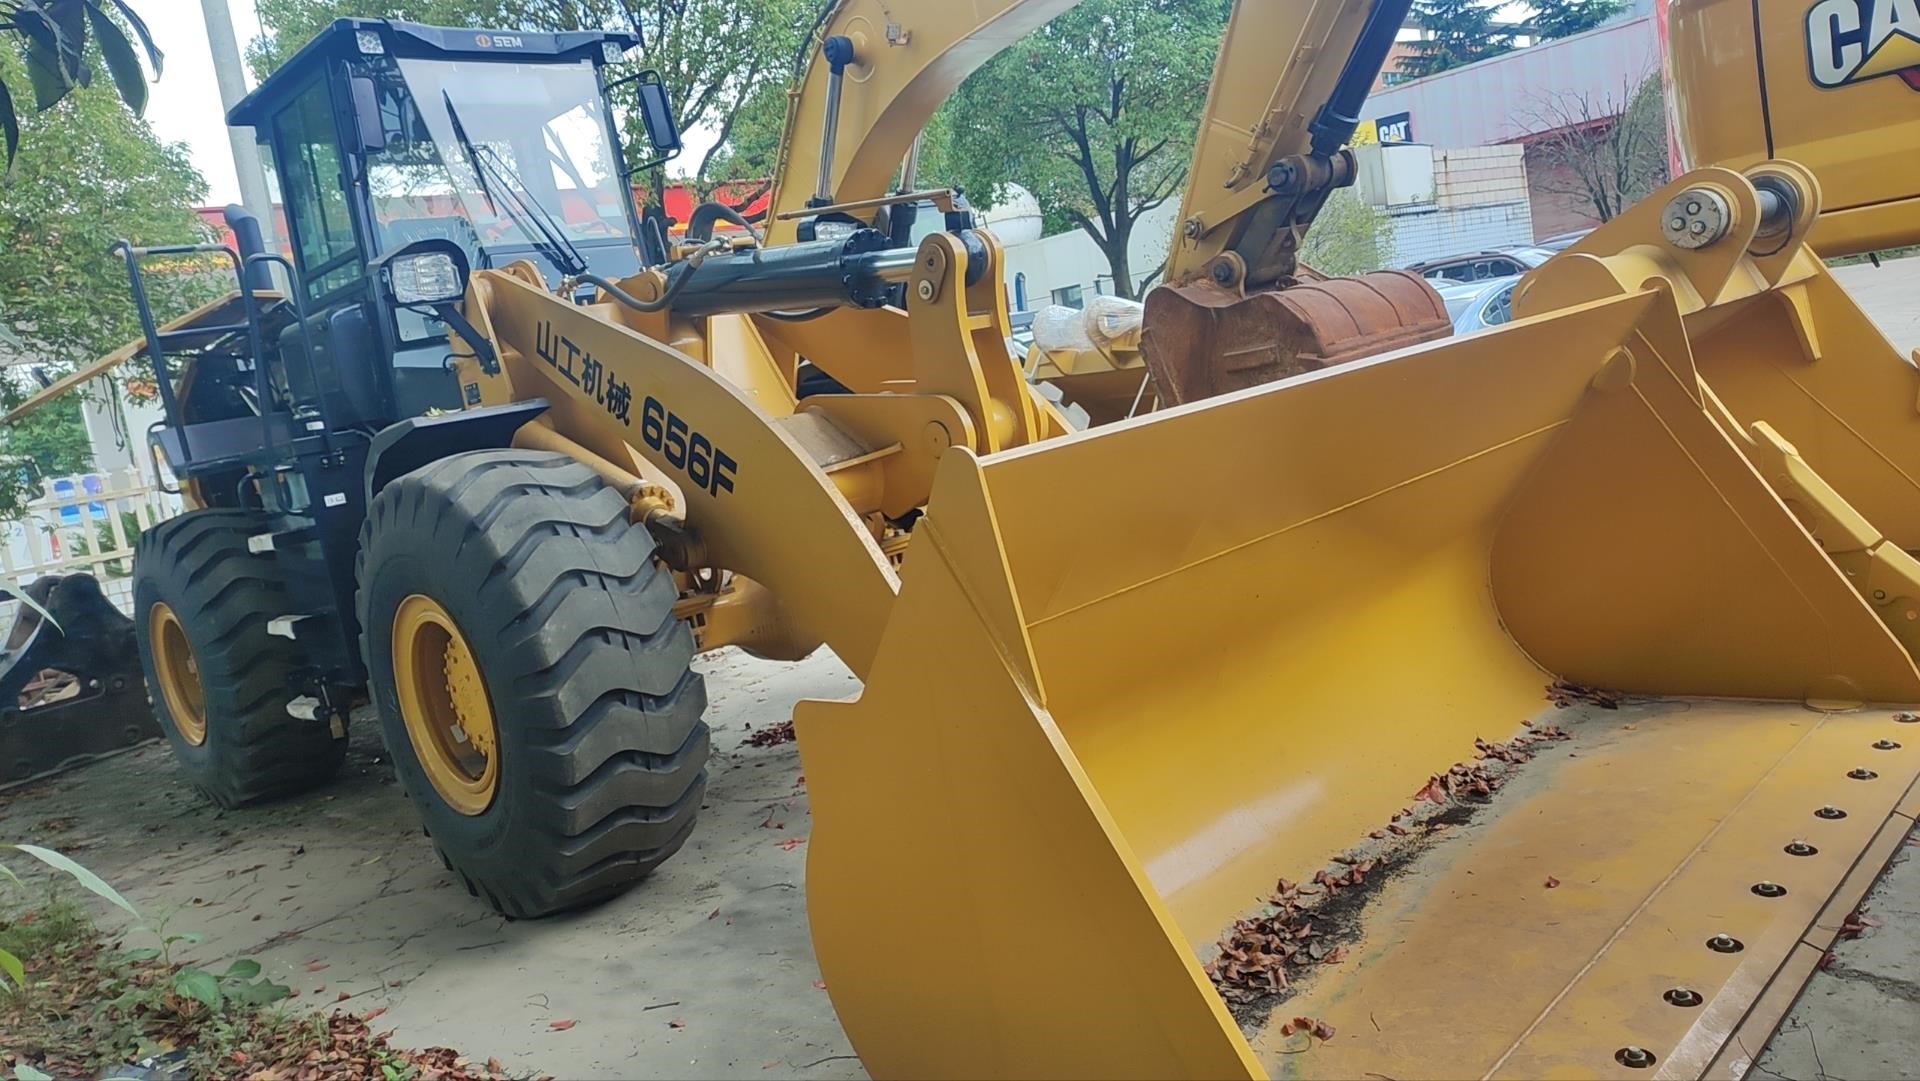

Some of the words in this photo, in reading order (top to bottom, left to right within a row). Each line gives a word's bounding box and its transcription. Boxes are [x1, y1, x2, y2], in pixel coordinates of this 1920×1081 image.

[493, 36, 523, 48] SEM
[1379, 121, 1408, 142] CAT
[536, 320, 632, 427] 山工机械
[641, 396, 738, 498] 656F
